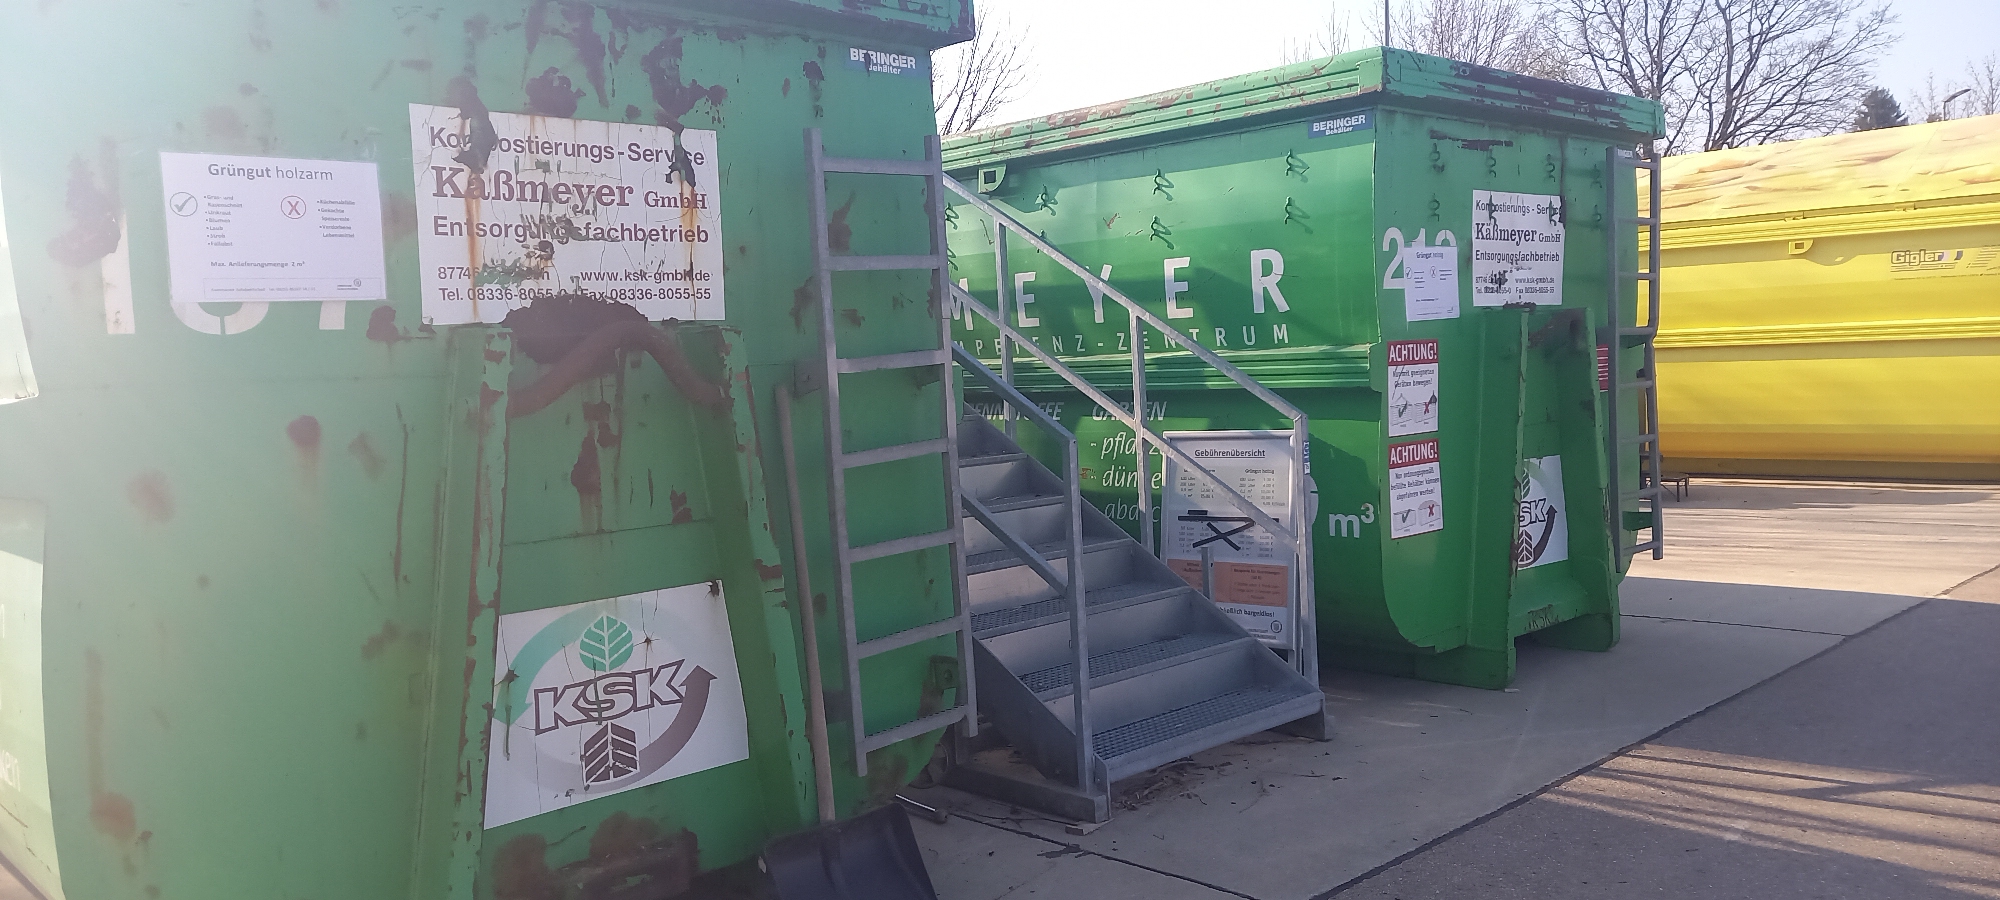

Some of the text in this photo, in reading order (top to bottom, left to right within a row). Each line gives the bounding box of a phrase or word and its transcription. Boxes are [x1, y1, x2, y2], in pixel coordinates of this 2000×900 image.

[850, 48, 916, 69] BERINGER
[1313, 114, 1366, 131] BERINGER
[430, 126, 705, 166] Koostierungs-Servce
[208, 163, 333, 181] Grüngut holzarm
[644, 190, 708, 209] GmbH
[434, 215, 709, 245] Entsorgungfachbetrieb
[1475, 222, 1537, 246] Käßmeyer
[1538, 232, 1562, 243] GmbH
[1475, 249, 1560, 263] Entsorgungsfachbetrieb
[1890, 248, 1944, 267] Gigler
[439, 287, 464, 301] Tel.
[610, 287, 711, 301] 08336-8055-55
[1388, 342, 1437, 363] ACHTUNG!
[1194, 448, 1265, 458] Gebührenübersicht
[1389, 441, 1438, 465] ACHTUNG!
[533, 658, 688, 736] KSK
